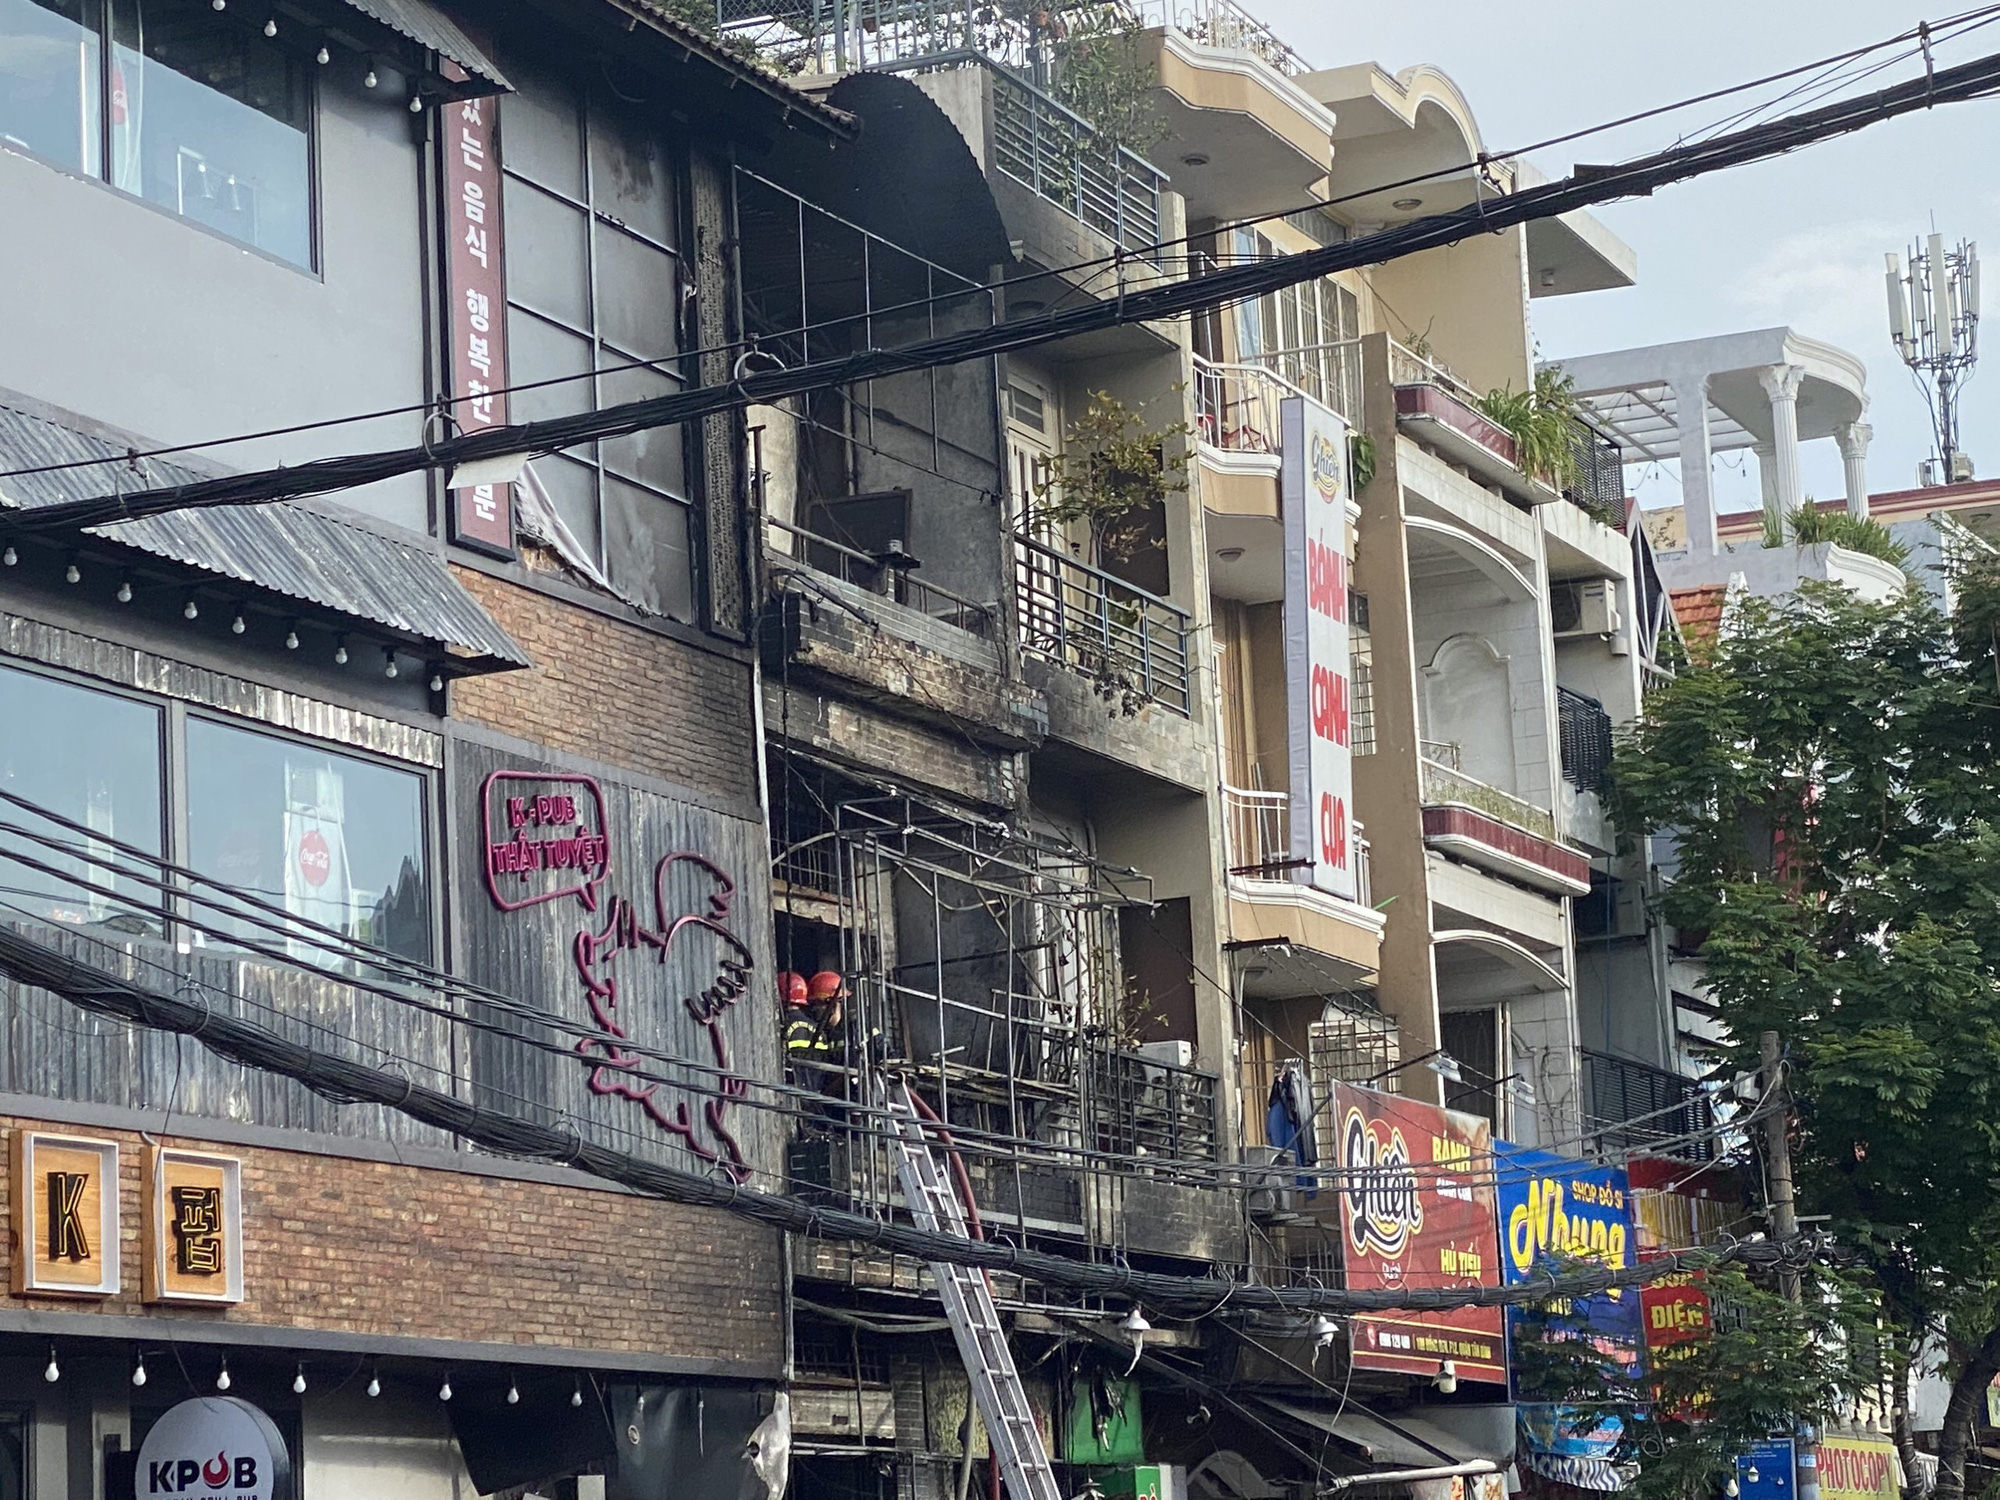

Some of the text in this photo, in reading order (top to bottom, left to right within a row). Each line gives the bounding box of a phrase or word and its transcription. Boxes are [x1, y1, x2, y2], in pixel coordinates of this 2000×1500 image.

[462, 180, 488, 270] 음식
[465, 288, 494, 425] 행복한
[1308, 528, 1346, 625] BÁNH
[1312, 663, 1349, 749] CANH
[507, 794, 576, 828] K-PUB
[1320, 791, 1347, 871] CUA
[491, 825, 605, 882] THẬT TUYỆT
[1432, 1129, 1471, 1172] BÁNH
[48, 1172, 90, 1261] K
[1572, 1180, 1597, 1204] SHOP
[1441, 1241, 1482, 1279] HỦ TIẾU
[1509, 1177, 1627, 1304] Nhung
[1651, 1299, 1704, 1332] ĐIỆN
[149, 1450, 258, 1494] KPUB
[1815, 1444, 1893, 1494] PHOTOCOPY
